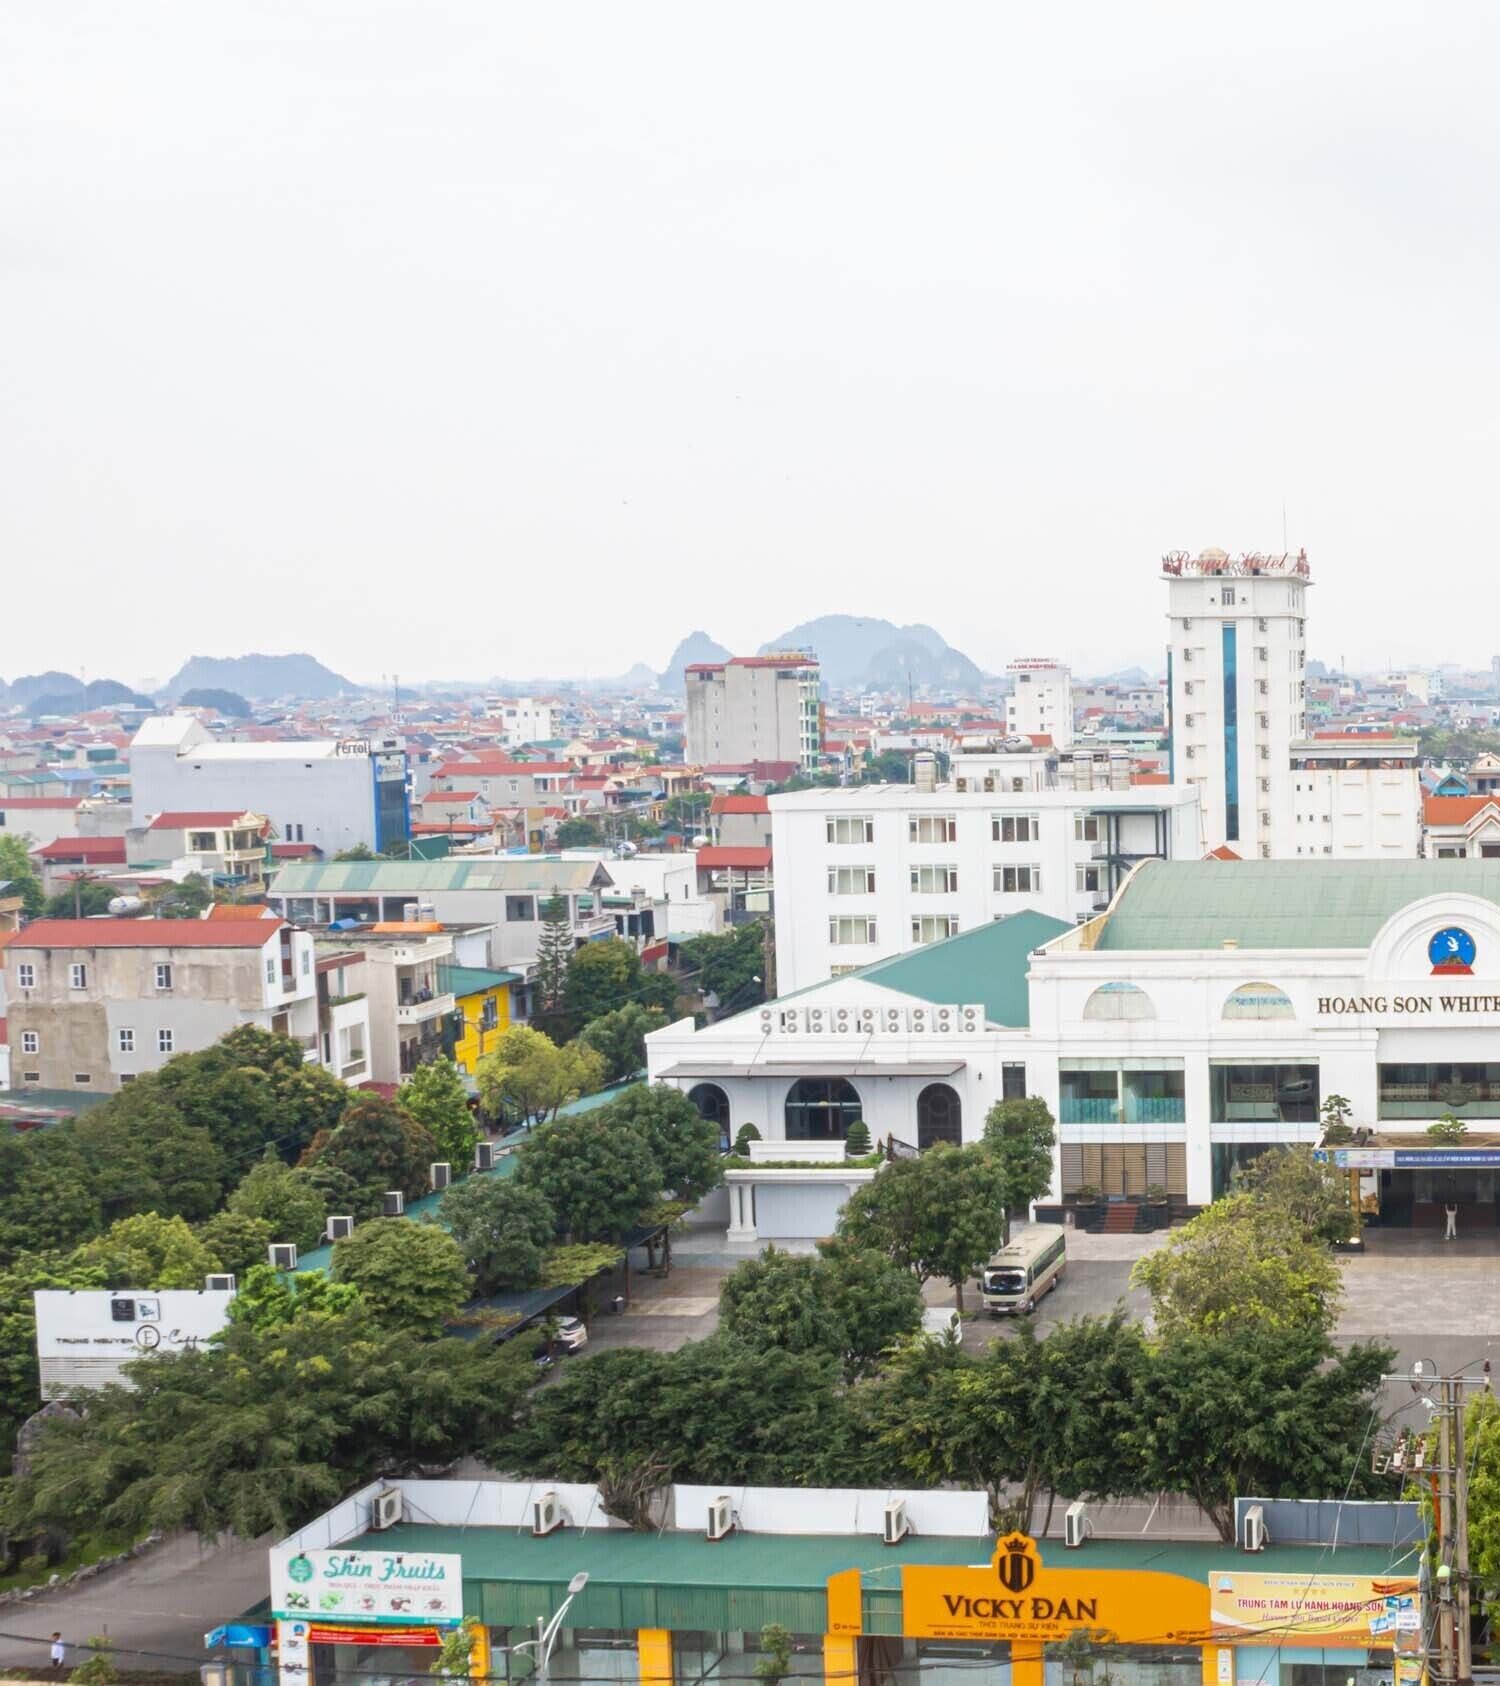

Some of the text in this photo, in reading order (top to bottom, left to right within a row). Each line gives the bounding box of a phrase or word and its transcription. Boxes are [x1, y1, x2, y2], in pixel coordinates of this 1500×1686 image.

[1317, 997, 1388, 1014] HOANG
[1393, 996, 1433, 1013] SON
[323, 1556, 446, 1581] Shin Fruits
[1032, 1596, 1098, 1621] ĐAN
